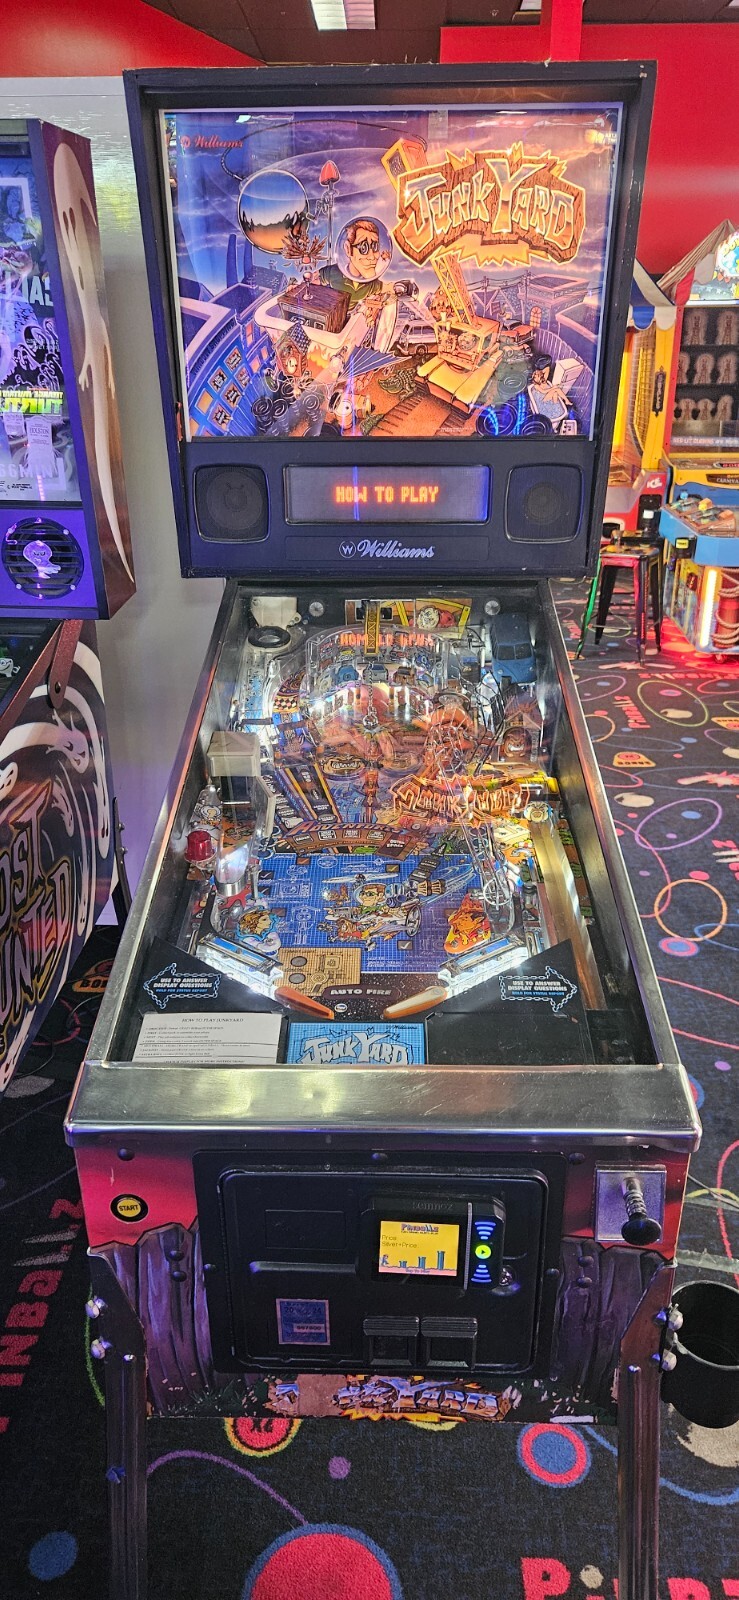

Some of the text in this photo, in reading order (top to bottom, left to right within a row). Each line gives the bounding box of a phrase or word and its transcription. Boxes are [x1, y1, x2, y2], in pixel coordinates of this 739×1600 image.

[194, 134, 243, 149] Williams
[647, 477, 662, 489] ICE
[335, 486, 438, 503] HOW TO PLAY
[357, 539, 433, 558] Williams
